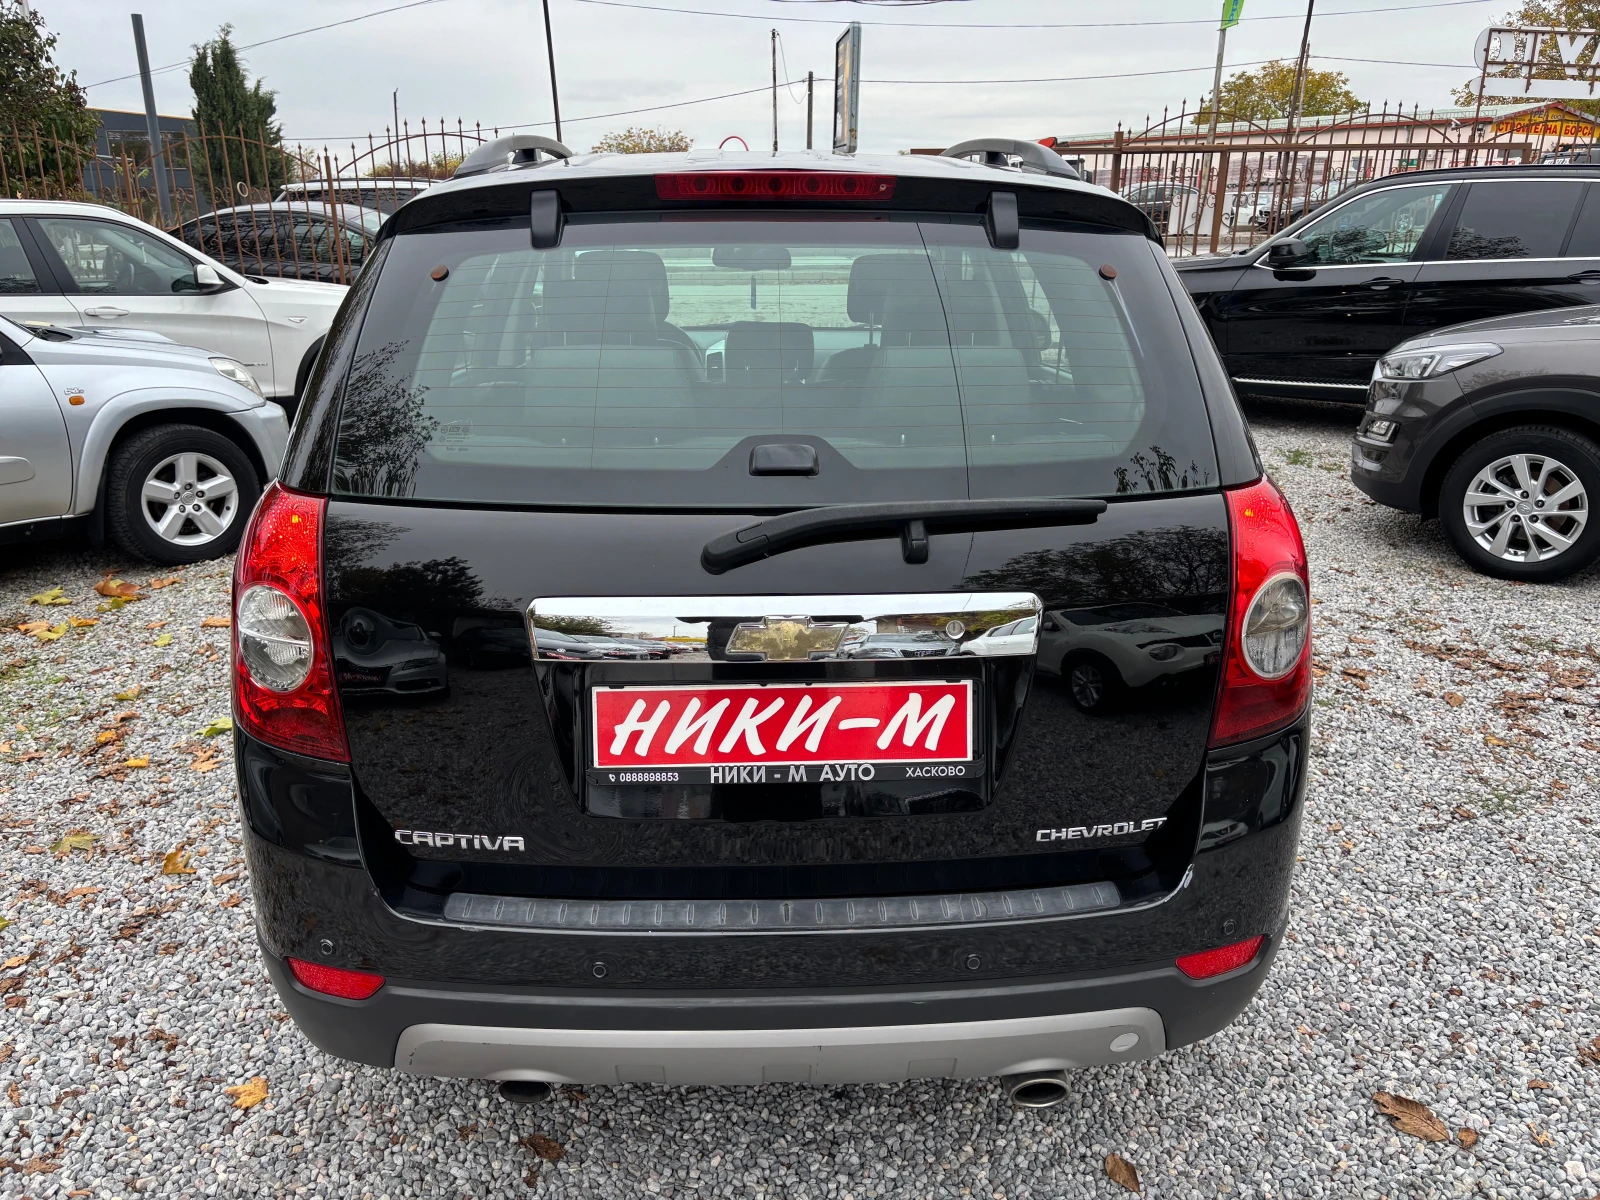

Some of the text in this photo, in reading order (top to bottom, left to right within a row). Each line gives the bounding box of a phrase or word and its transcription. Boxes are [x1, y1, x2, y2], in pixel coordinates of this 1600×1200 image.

[609, 692, 956, 757] НИКИ-М
[619, 772, 679, 782] 0888898853
[710, 765, 766, 784] НИКИ
[787, 765, 808, 782] М
[819, 763, 876, 782] АУТО
[905, 765, 966, 778] ХАСКОВО
[1036, 816, 1168, 842] CHEVROLET
[394, 829, 526, 852] CAPTIVA
